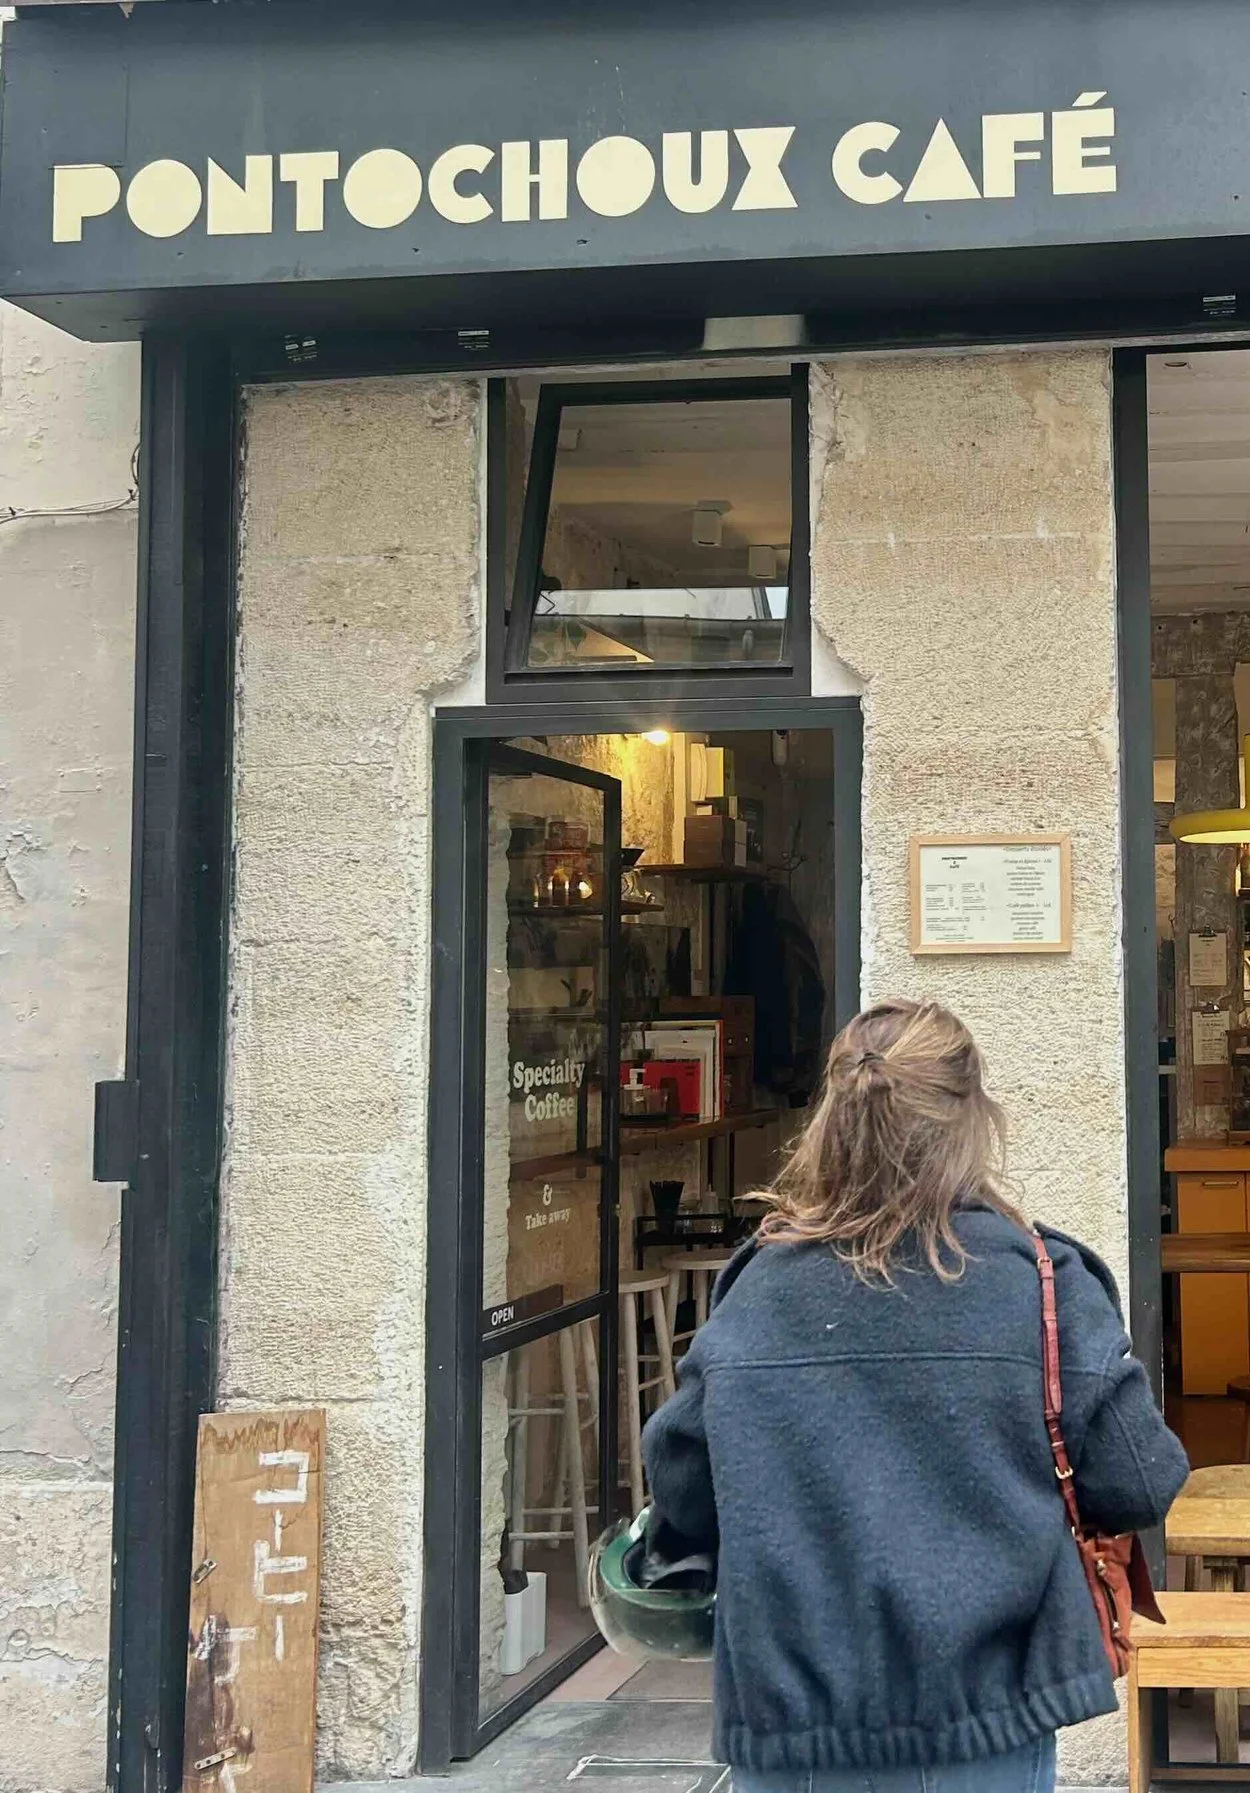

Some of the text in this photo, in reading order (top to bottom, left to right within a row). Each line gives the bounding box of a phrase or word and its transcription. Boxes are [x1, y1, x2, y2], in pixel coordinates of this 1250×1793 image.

[53, 91, 1117, 243] PONTOCHOUX CAFÉ
[513, 1058, 585, 1093] Specialty
[525, 1092, 575, 1121] Coffee
[542, 1184, 553, 1206] &
[525, 1208, 571, 1230] Take away
[491, 1305, 514, 1326] OPEN
[252, 1448, 310, 1663] コーヒー
